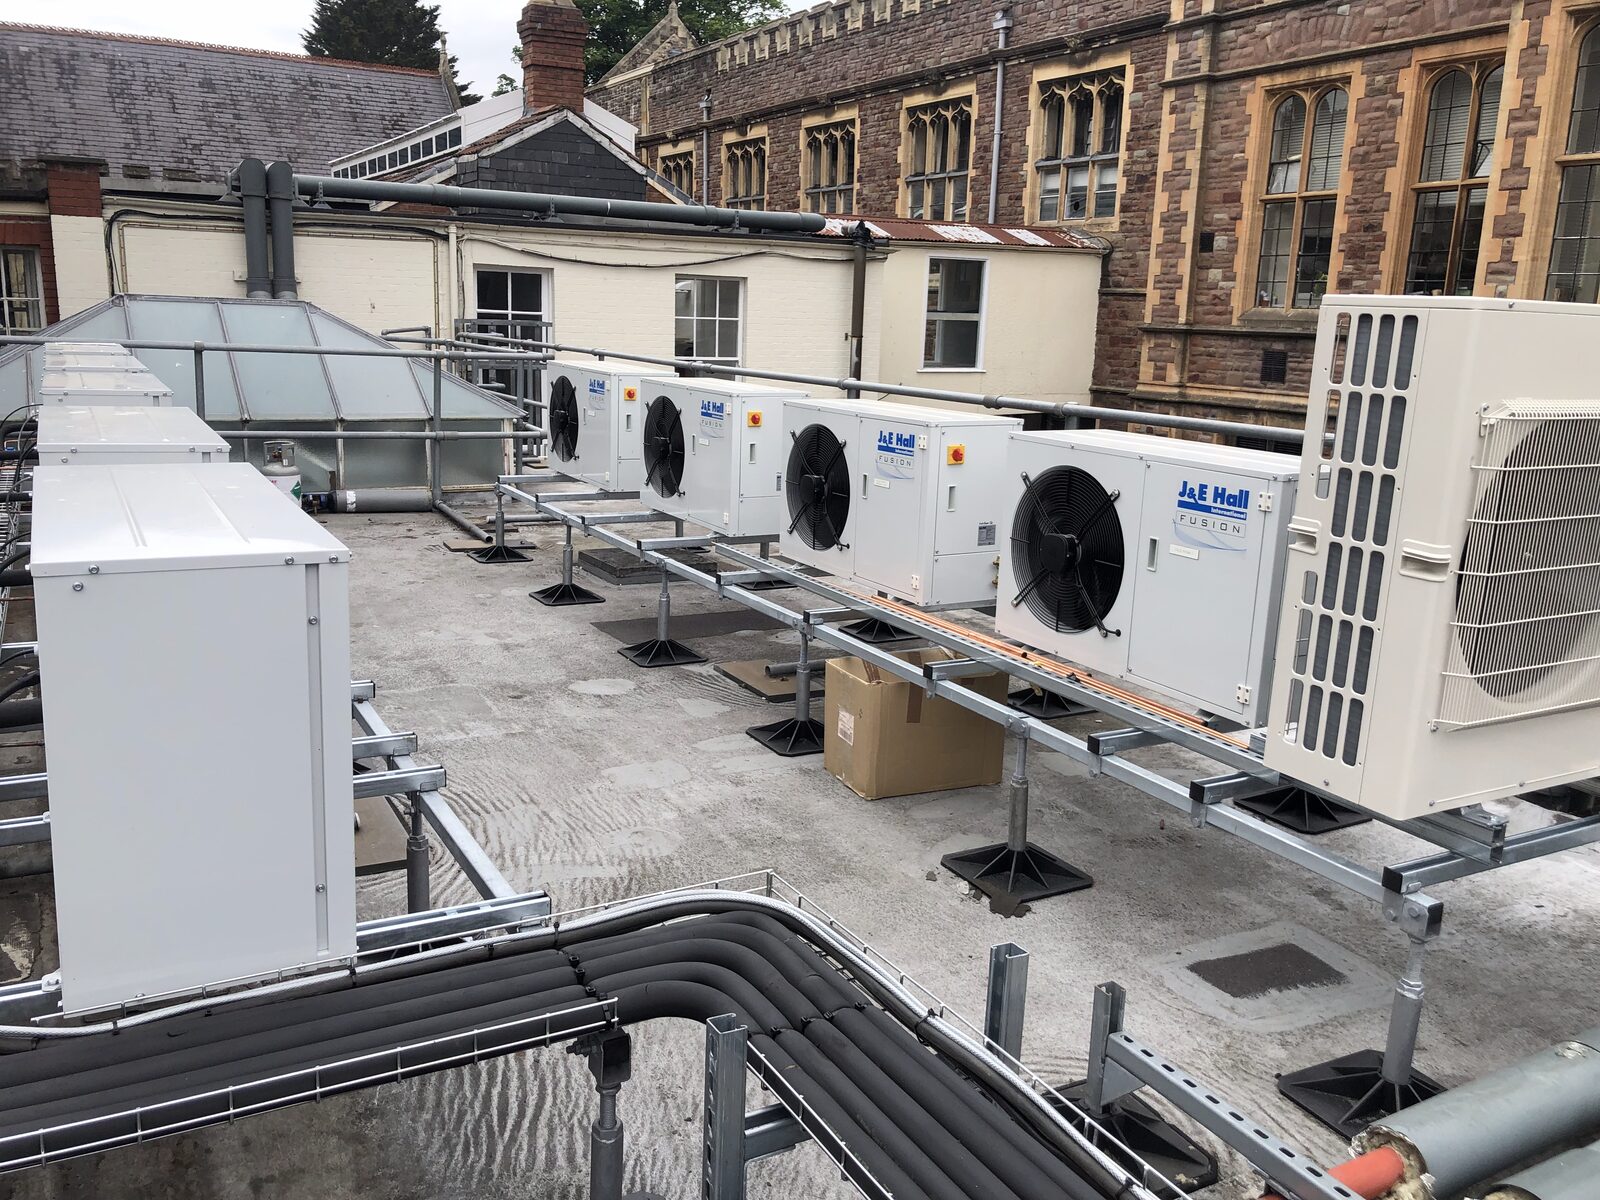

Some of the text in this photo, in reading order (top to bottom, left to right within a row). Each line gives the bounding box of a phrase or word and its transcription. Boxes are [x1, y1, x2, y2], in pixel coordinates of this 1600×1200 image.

[701, 400, 724, 414] J&E Hall
[878, 430, 915, 448] J&E Hall
[879, 455, 911, 466] FUSION
[1179, 480, 1250, 509] J&E Hall
[1180, 514, 1241, 534] FUSION
